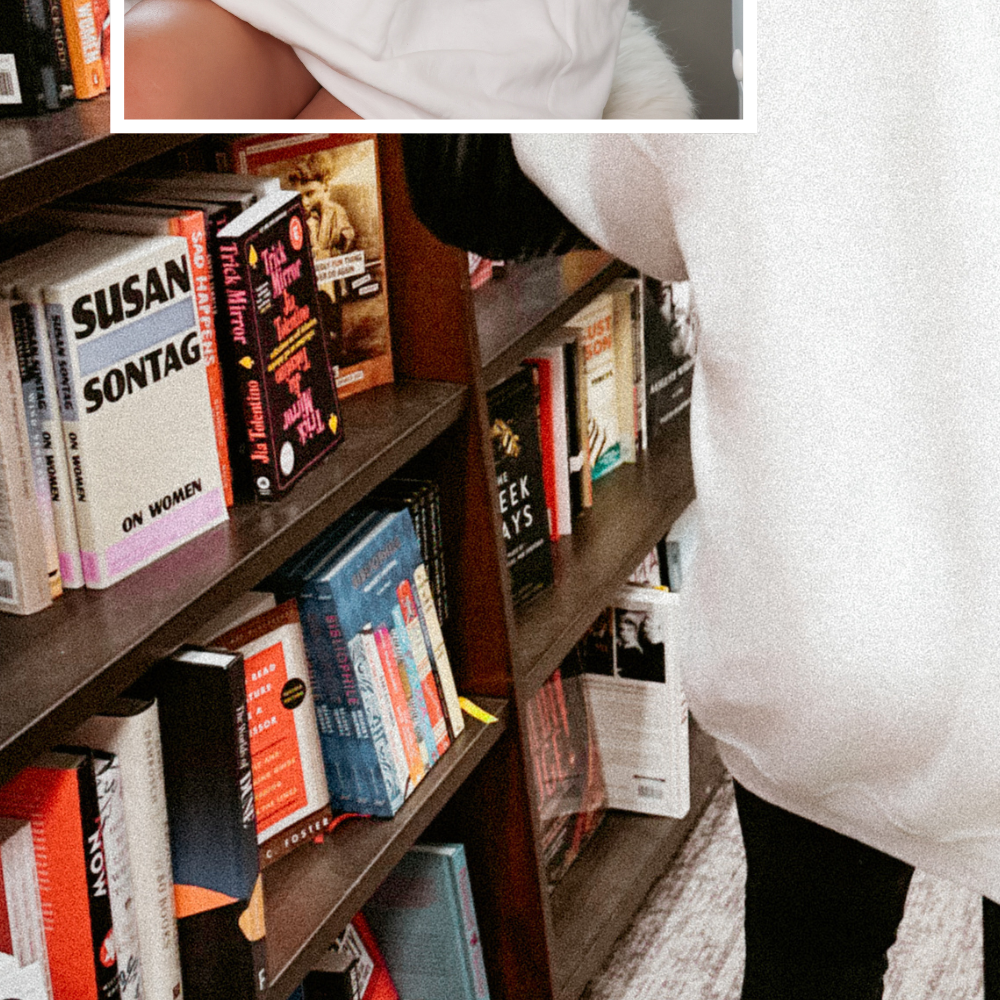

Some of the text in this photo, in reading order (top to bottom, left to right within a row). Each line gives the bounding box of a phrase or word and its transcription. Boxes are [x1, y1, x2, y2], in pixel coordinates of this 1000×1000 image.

[77, 1, 101, 65] WOMEN
[191, 231, 205, 269] SAD
[71, 254, 193, 340] SUSAN
[195, 274, 215, 368] HAPPENS
[219, 242, 247, 345] Trick Mirror
[52, 313, 73, 411] SUSAN SONTAG
[83, 331, 201, 413] SONTAG
[247, 379, 269, 464] Jia Tolentino
[42, 431, 60, 502] ON WOMEN
[68, 432, 87, 502] ON WOMEN
[497, 471, 508, 486] HE
[499, 475, 530, 514] EEK
[122, 478, 203, 534] ON WOMEN
[502, 504, 533, 539] AYS
[251, 663, 277, 681] READ
[325, 614, 359, 706] BIBLIOPHILE
[247, 683, 272, 703] TURE
[255, 706, 263, 716] A
[88, 831, 107, 896] NOW
[284, 817, 329, 847] FOSTER
